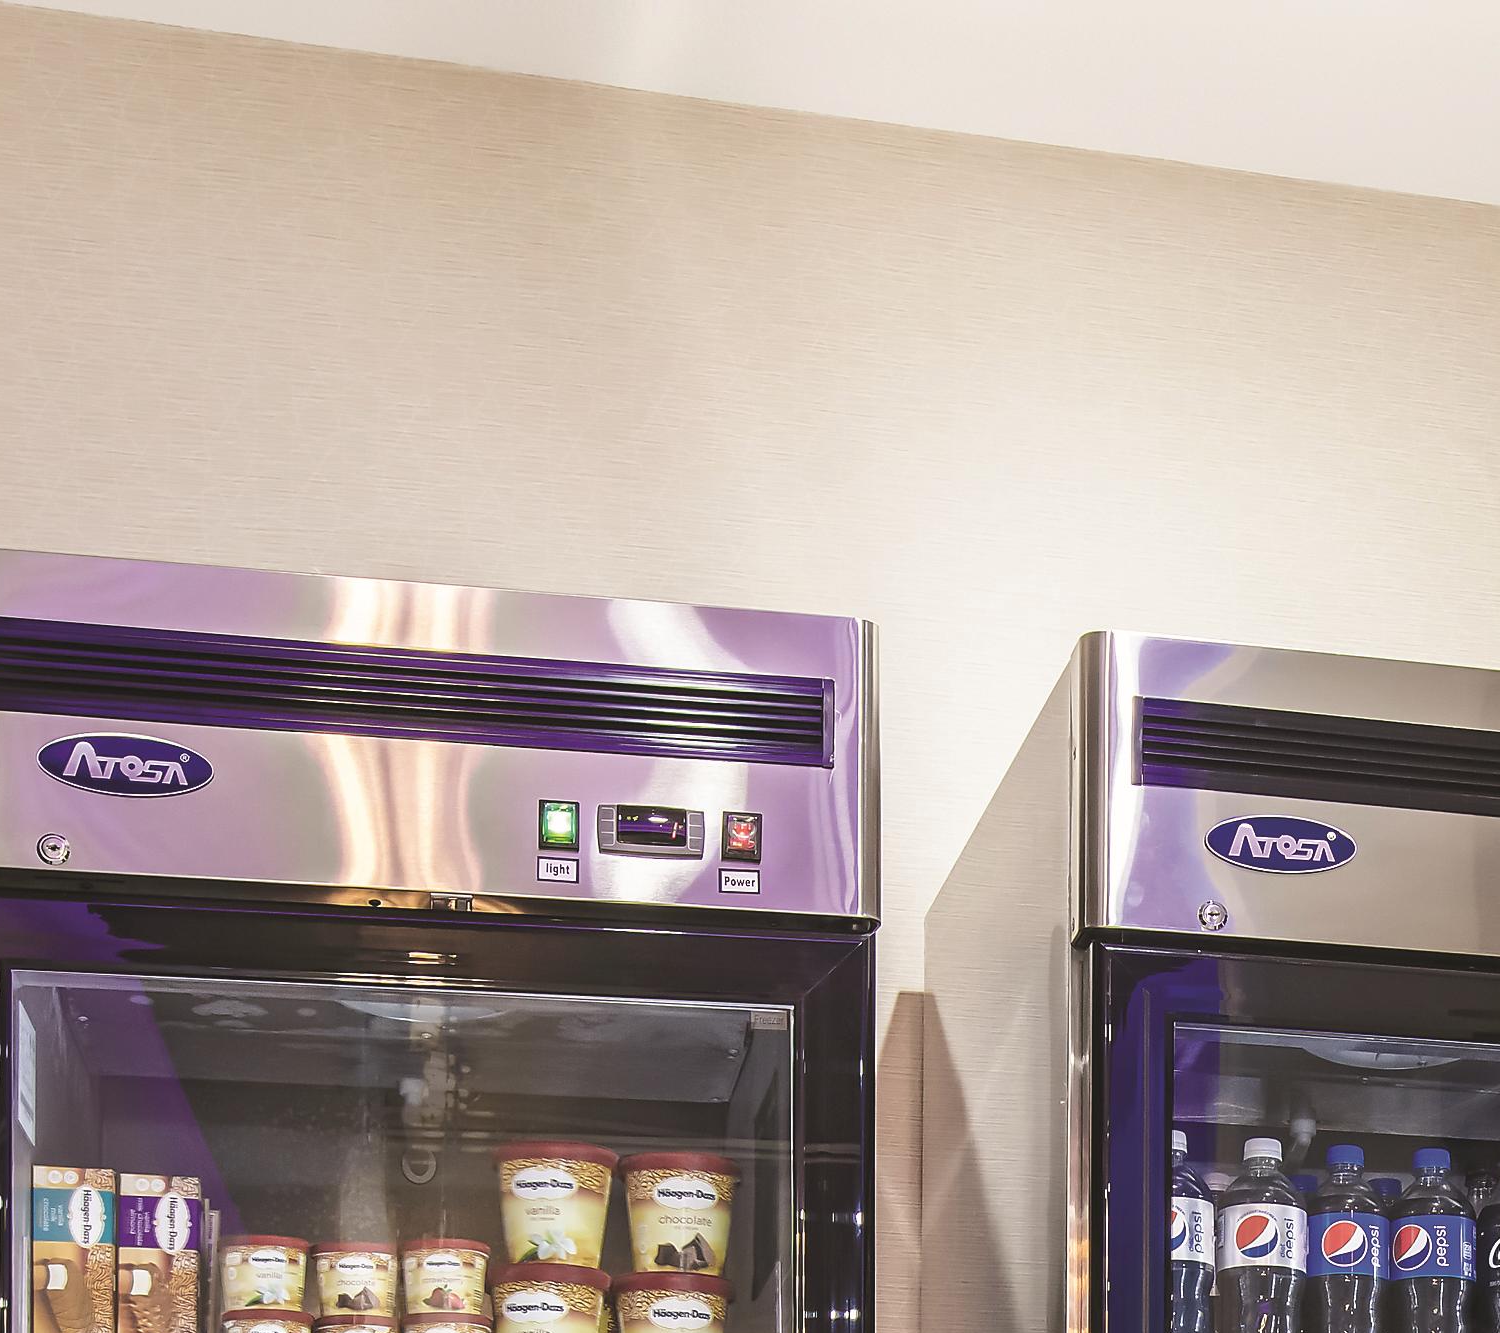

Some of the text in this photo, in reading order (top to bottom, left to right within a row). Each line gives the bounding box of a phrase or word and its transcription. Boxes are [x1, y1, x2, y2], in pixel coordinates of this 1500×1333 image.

[62, 742, 190, 786] ATOSA
[1229, 823, 1336, 862] ATOSA
[545, 862, 571, 879] light
[722, 874, 757, 890] Power
[1192, 1210, 1206, 1254] pepsi
[1283, 1216, 1297, 1261] pepsi
